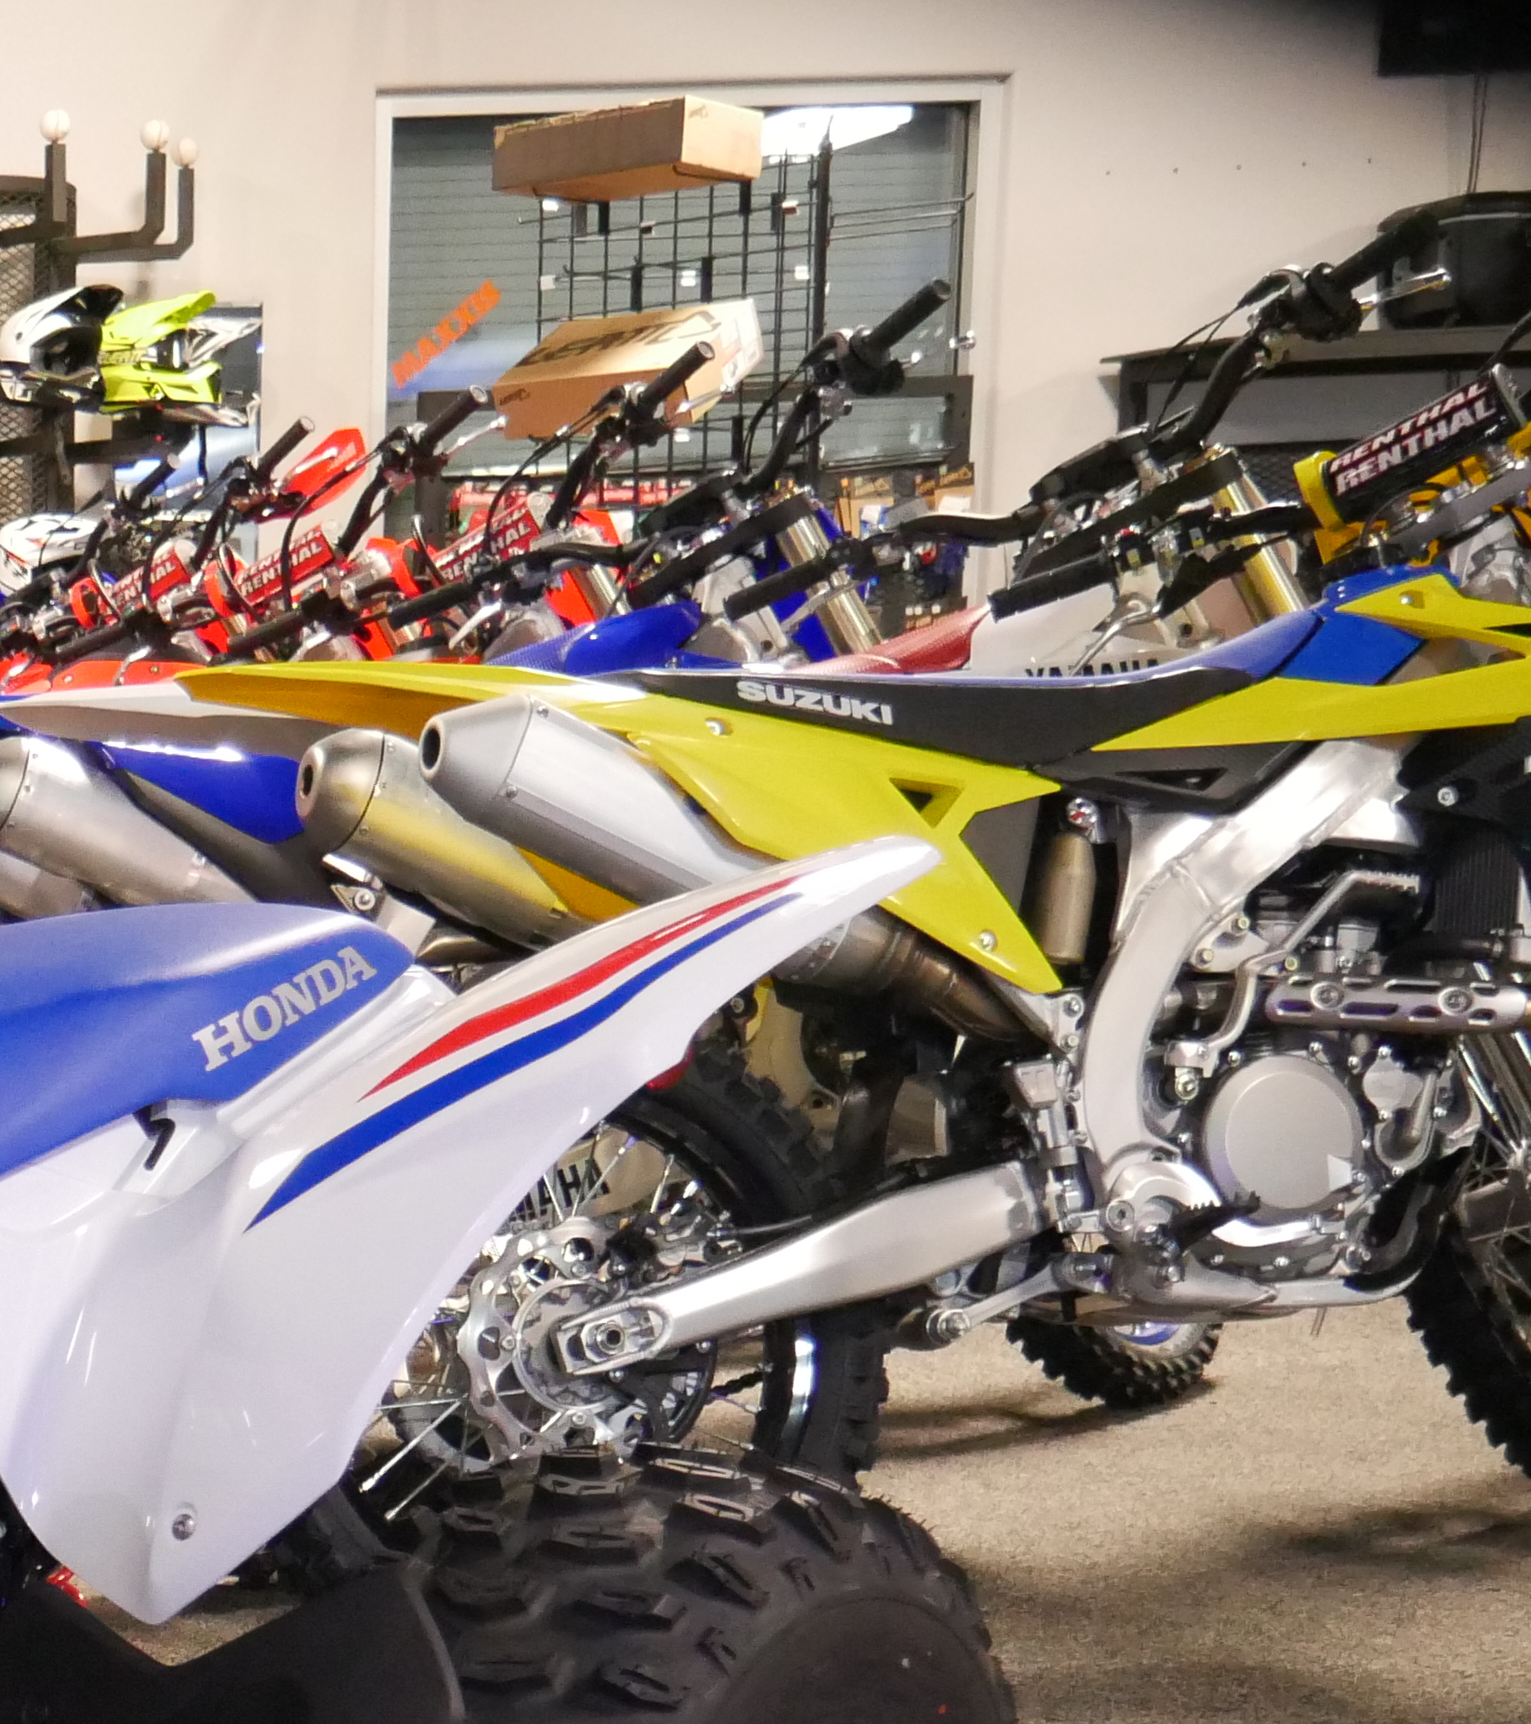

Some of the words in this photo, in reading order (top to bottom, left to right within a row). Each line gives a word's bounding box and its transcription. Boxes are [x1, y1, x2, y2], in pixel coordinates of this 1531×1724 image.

[1329, 383, 1488, 474] RENTHAL
[1336, 397, 1497, 497] RENTHAL
[736, 679, 894, 726] SUZUKI
[191, 945, 378, 1073] HONDA
